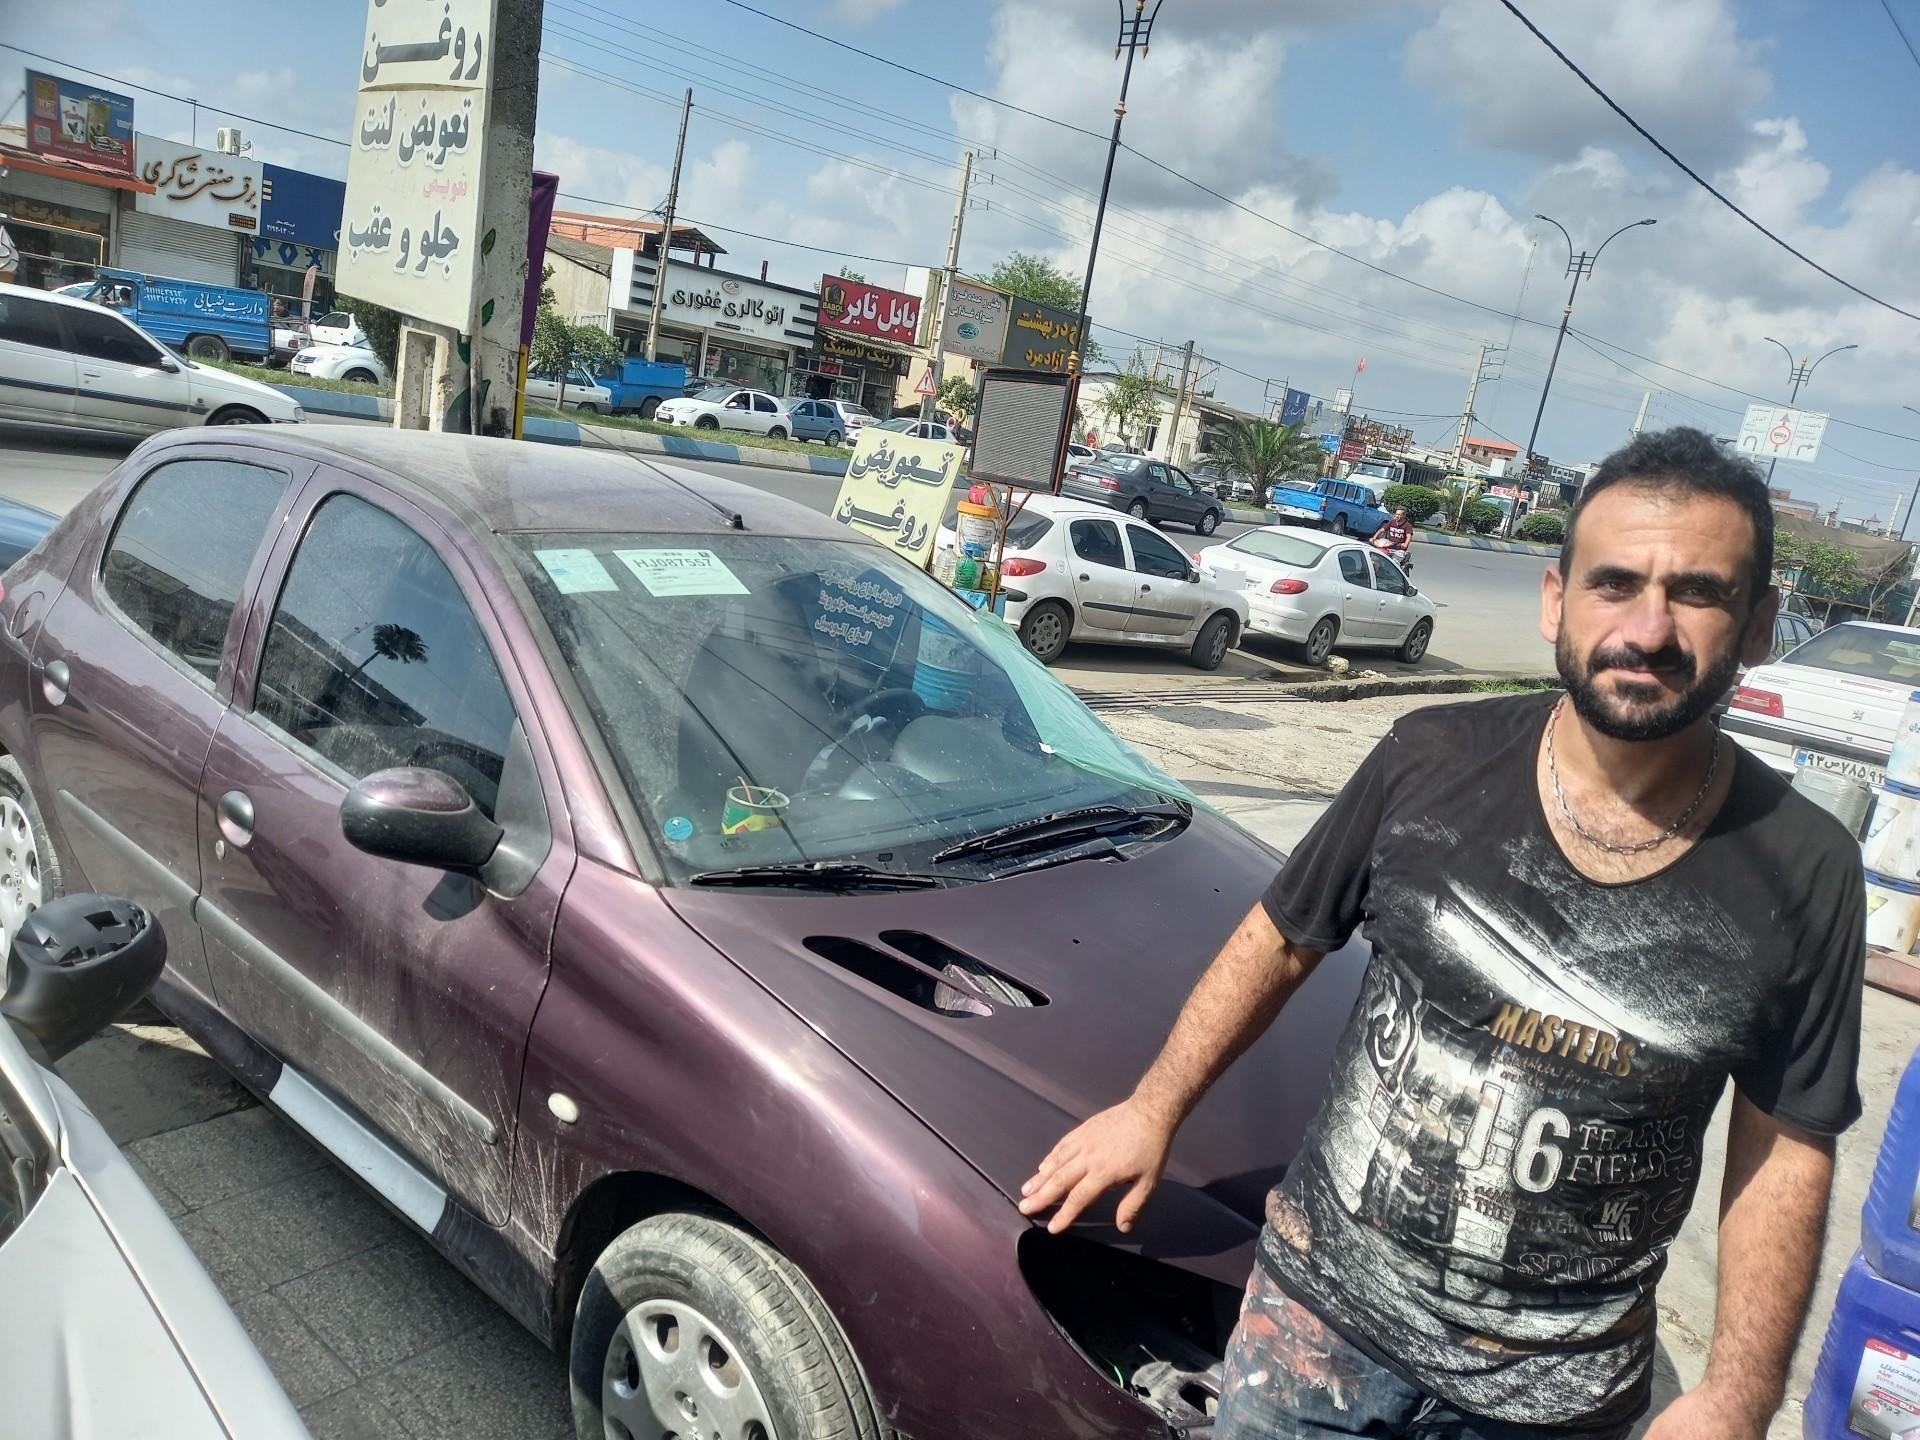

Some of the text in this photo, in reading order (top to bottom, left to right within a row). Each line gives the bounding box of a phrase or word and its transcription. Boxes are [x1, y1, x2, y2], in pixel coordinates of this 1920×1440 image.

[362, 2, 483, 83] روغن
[360, 95, 471, 165] تعویض لنت
[348, 204, 460, 275] جلو و عقب
[839, 290, 916, 337] بابل تایر
[850, 438, 956, 488] تعویض
[836, 496, 930, 551] روغن
[1489, 1002, 1637, 1078] MASTERS
